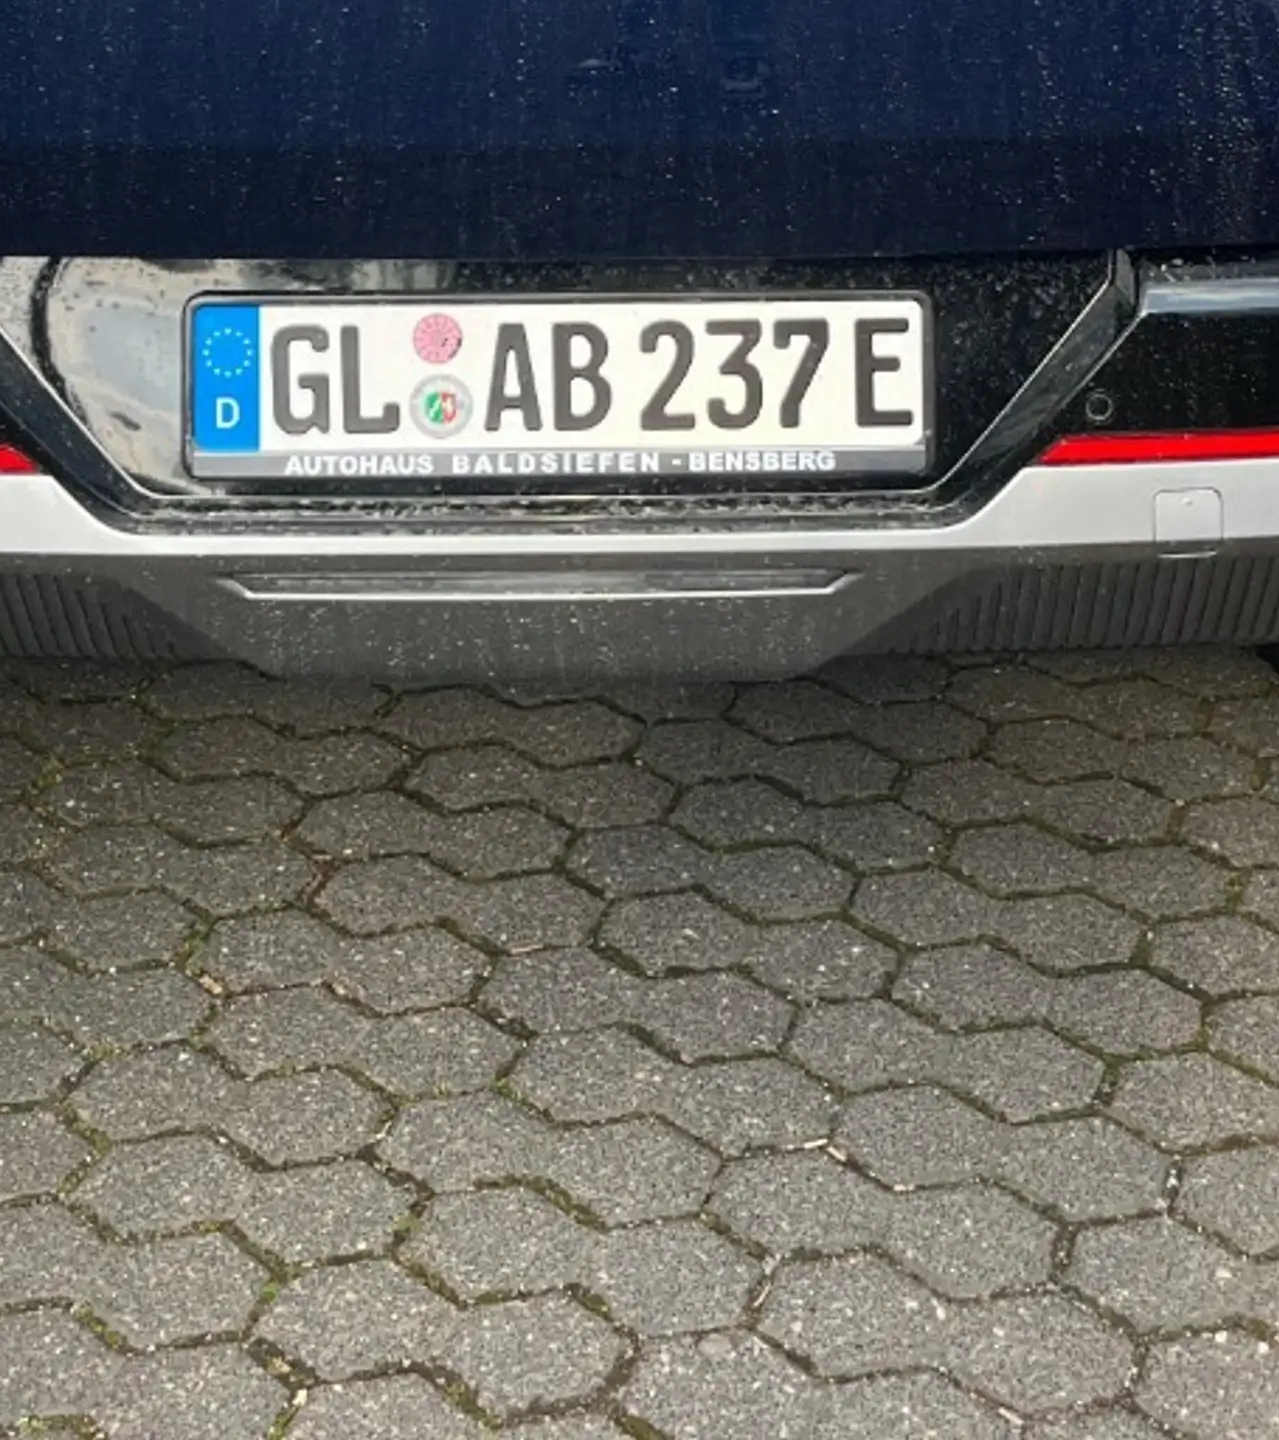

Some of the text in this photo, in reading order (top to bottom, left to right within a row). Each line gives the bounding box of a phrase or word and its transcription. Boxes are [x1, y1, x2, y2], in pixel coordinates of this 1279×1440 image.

[271, 324, 400, 435] GL
[483, 323, 612, 432] AB
[215, 398, 240, 428] D
[285, 455, 434, 476] AUTOHAUS
[453, 452, 659, 474] BALDSIEFEN
[689, 449, 836, 472] BENSBERG
